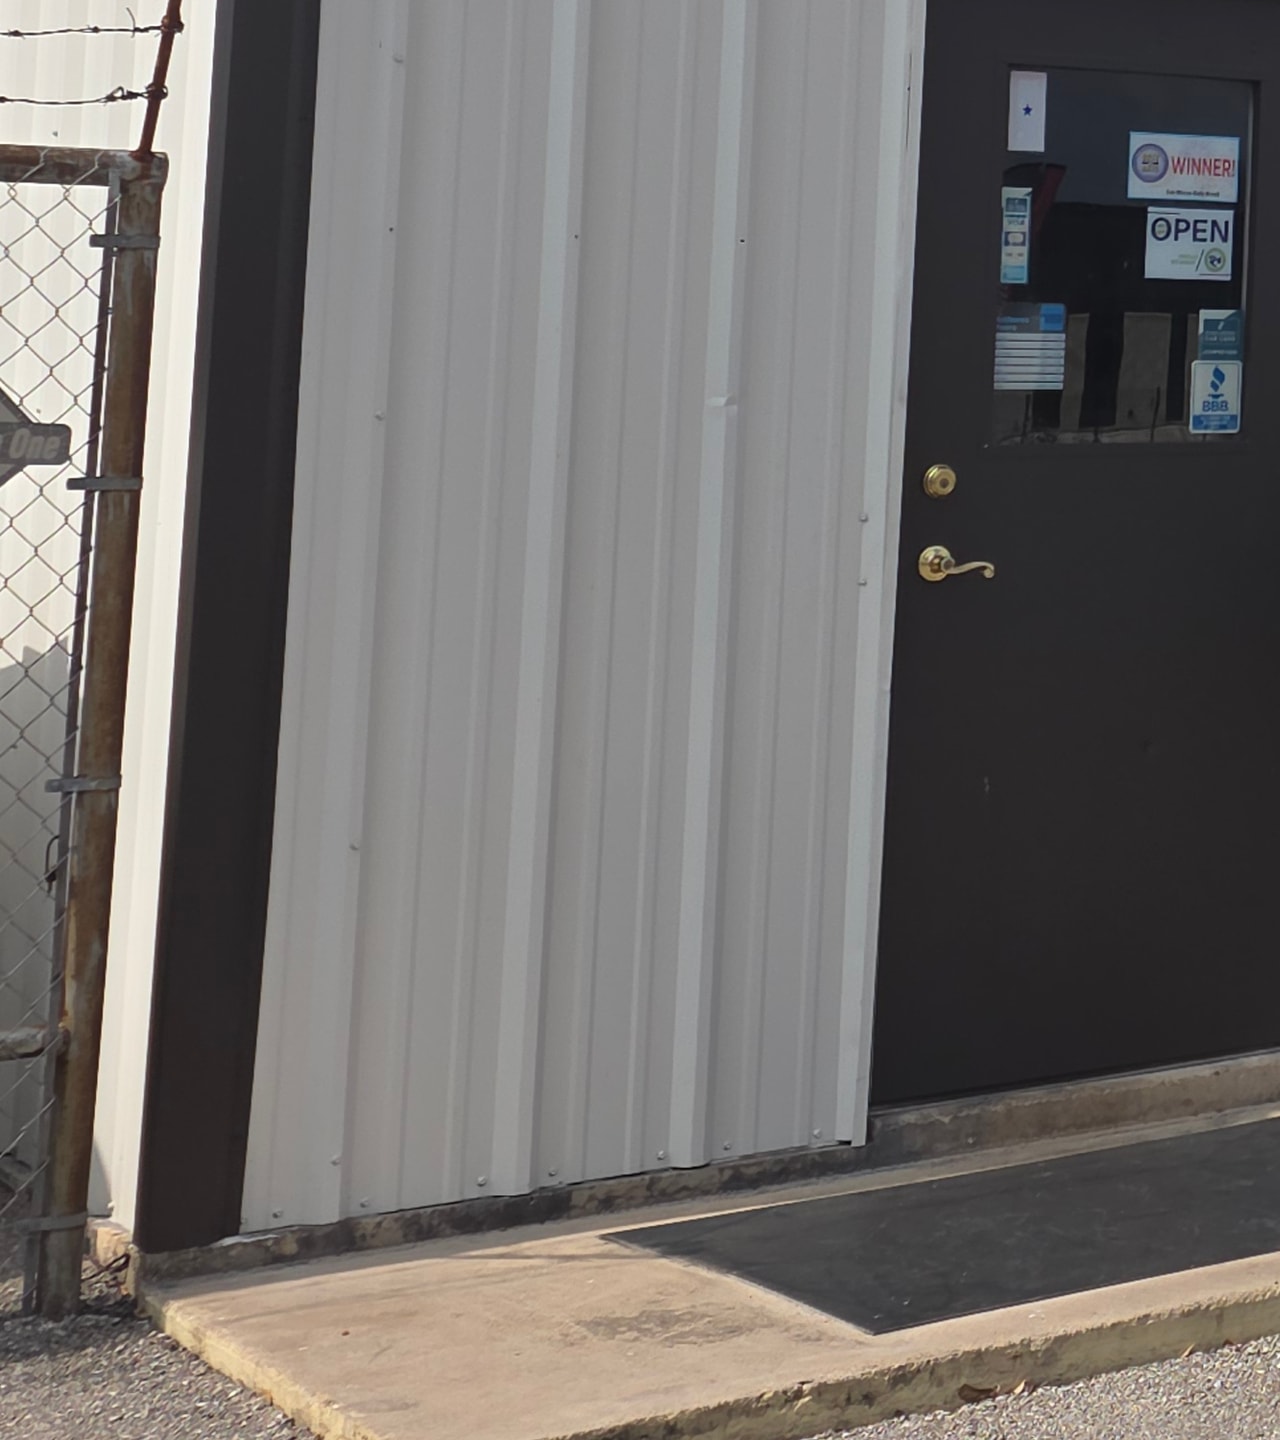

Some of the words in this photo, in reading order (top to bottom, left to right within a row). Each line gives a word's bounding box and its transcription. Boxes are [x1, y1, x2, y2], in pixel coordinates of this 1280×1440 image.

[1170, 155, 1235, 178] WINNER!
[1151, 217, 1230, 244] OPEN
[1202, 400, 1229, 413] BBB
[9, 428, 61, 460] One
